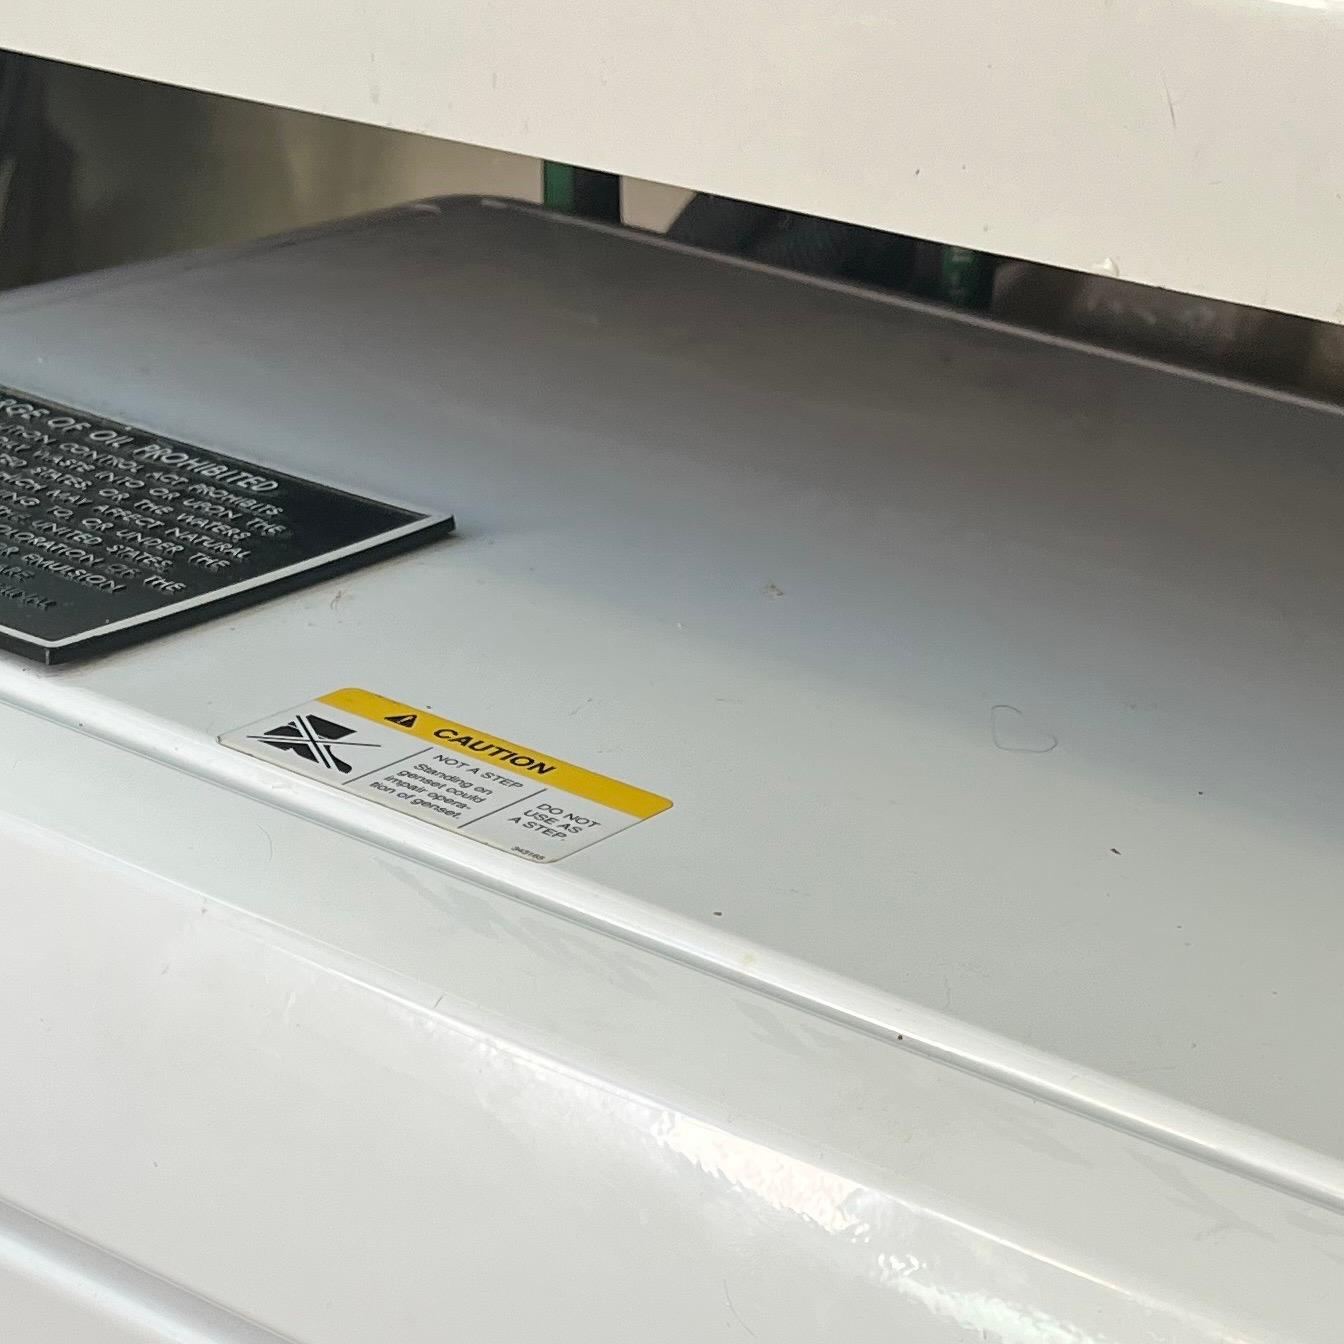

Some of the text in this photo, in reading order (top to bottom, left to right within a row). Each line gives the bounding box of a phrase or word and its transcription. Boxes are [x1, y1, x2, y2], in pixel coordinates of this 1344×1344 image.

[47, 416, 91, 431] OF
[88, 430, 133, 448] OIL
[132, 443, 278, 490] PROHIBITED
[59, 442, 283, 515] CONTROL ACT PROHIBITS
[94, 504, 249, 558] AFFECT NATURAL
[20, 553, 124, 591] EMULSION
[433, 728, 556, 774] CAUTION
[369, 781, 396, 793] tion
[383, 775, 428, 793] impair
[396, 770, 486, 803] genset could
[413, 763, 492, 795] Standing on
[433, 754, 469, 768] NOT
[480, 771, 523, 787] STEP
[523, 809, 582, 833] USE AS
[536, 803, 600, 827] DO NOT
